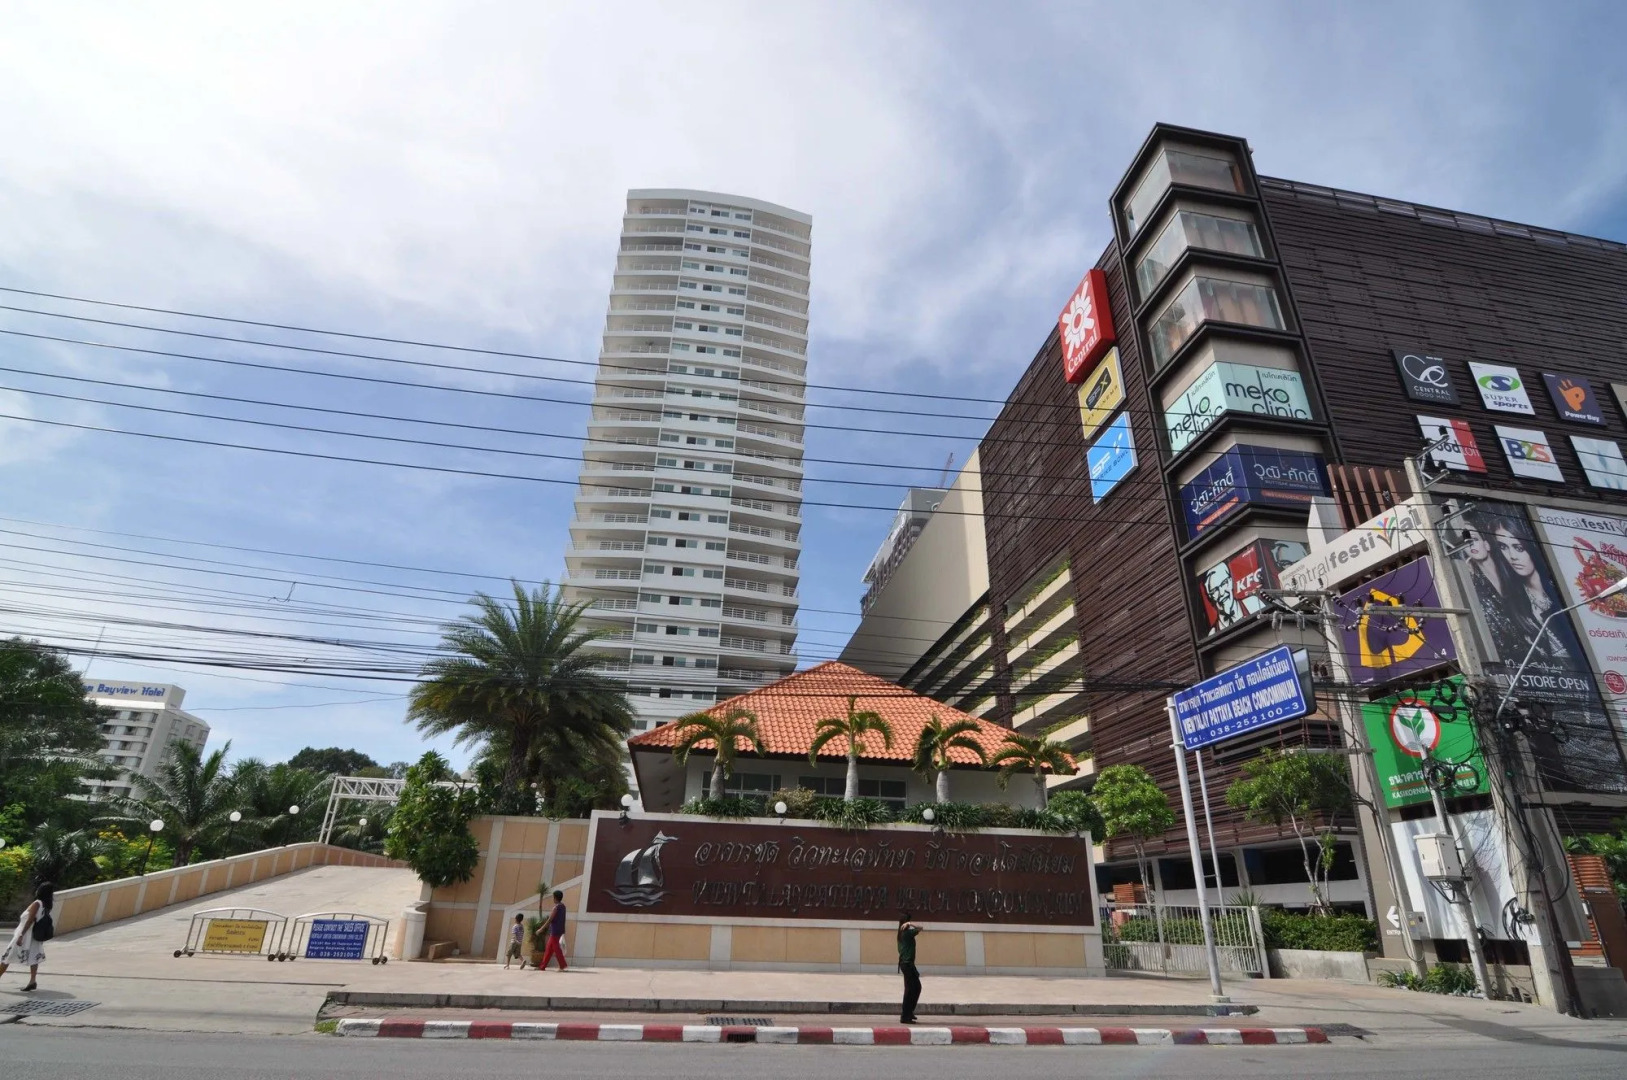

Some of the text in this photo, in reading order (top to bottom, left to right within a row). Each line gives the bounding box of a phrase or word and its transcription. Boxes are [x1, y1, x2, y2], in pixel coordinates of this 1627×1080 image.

[1068, 327, 1098, 373] Central
[1225, 370, 1290, 404] meko
[1413, 385, 1450, 396] CENTRAL
[1483, 393, 1518, 403] SUPER
[1493, 400, 1529, 410] sports
[1564, 410, 1586, 420] Power
[1169, 393, 1210, 443] meko
[1505, 439, 1550, 462] B2S
[1236, 568, 1263, 594] KFC
[97, 683, 138, 695] Bayview
[141, 686, 165, 697] Hotel
[1520, 675, 1557, 688] STORE
[1559, 677, 1590, 691] OPEN
[1208, 703, 1234, 727] PATTAYA
[1232, 696, 1253, 718] BEACH
[1252, 678, 1298, 711] CONDOMINIUM
[1188, 702, 1300, 744] Tel. 038-252100-3
[1391, 786, 1431, 799] KASIKORNBA
[695, 841, 780, 875] อาคารชุด
[803, 883, 888, 915] PATTAYA
[895, 886, 952, 914] BEACH
